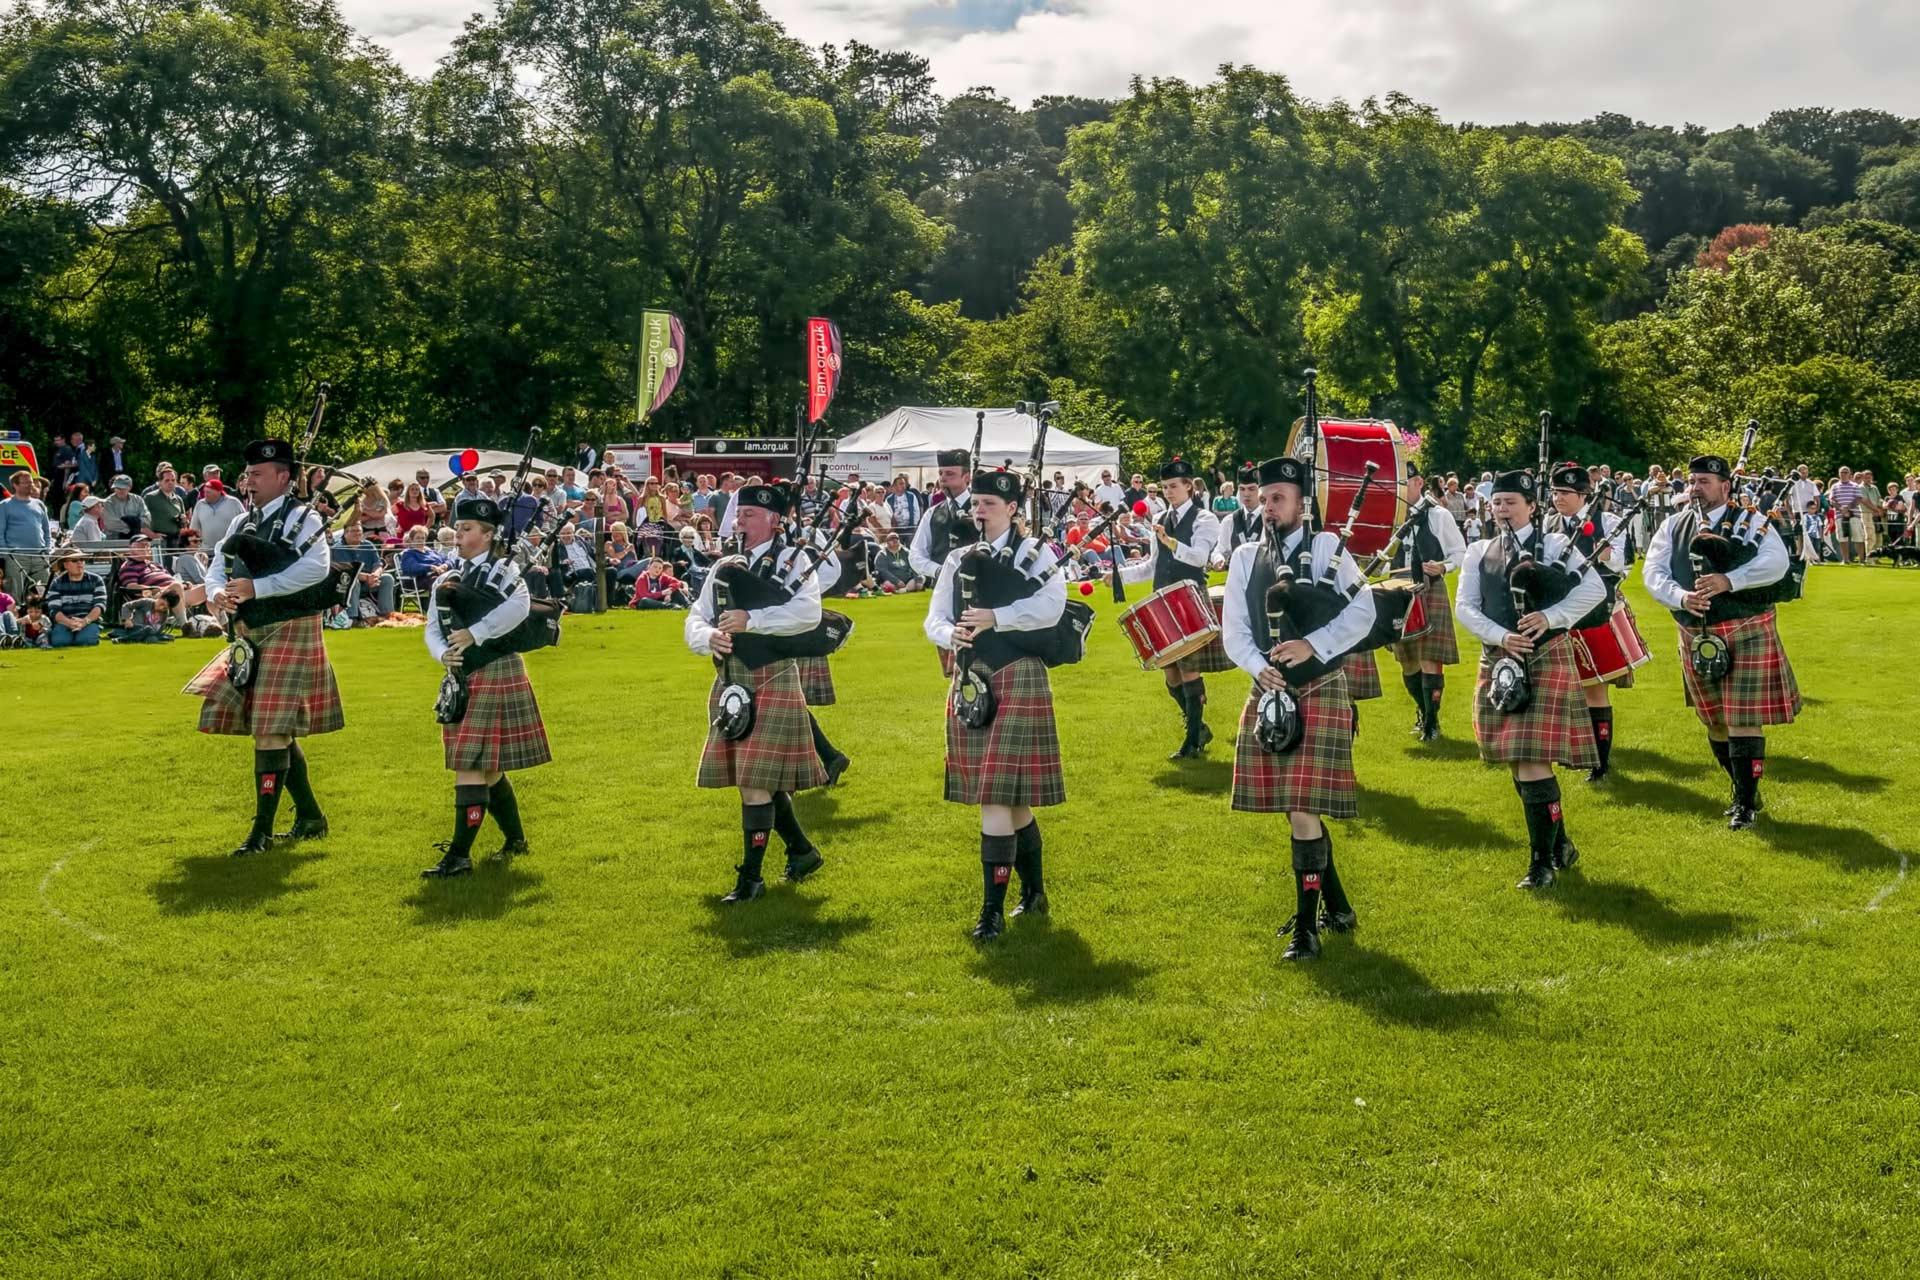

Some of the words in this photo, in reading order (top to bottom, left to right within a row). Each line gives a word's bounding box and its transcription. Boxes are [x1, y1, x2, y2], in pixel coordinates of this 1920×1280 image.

[645, 318, 662, 393] iam.org.uk
[815, 325, 828, 397] iam.org.uk
[744, 442, 789, 453] iam.org.uk
